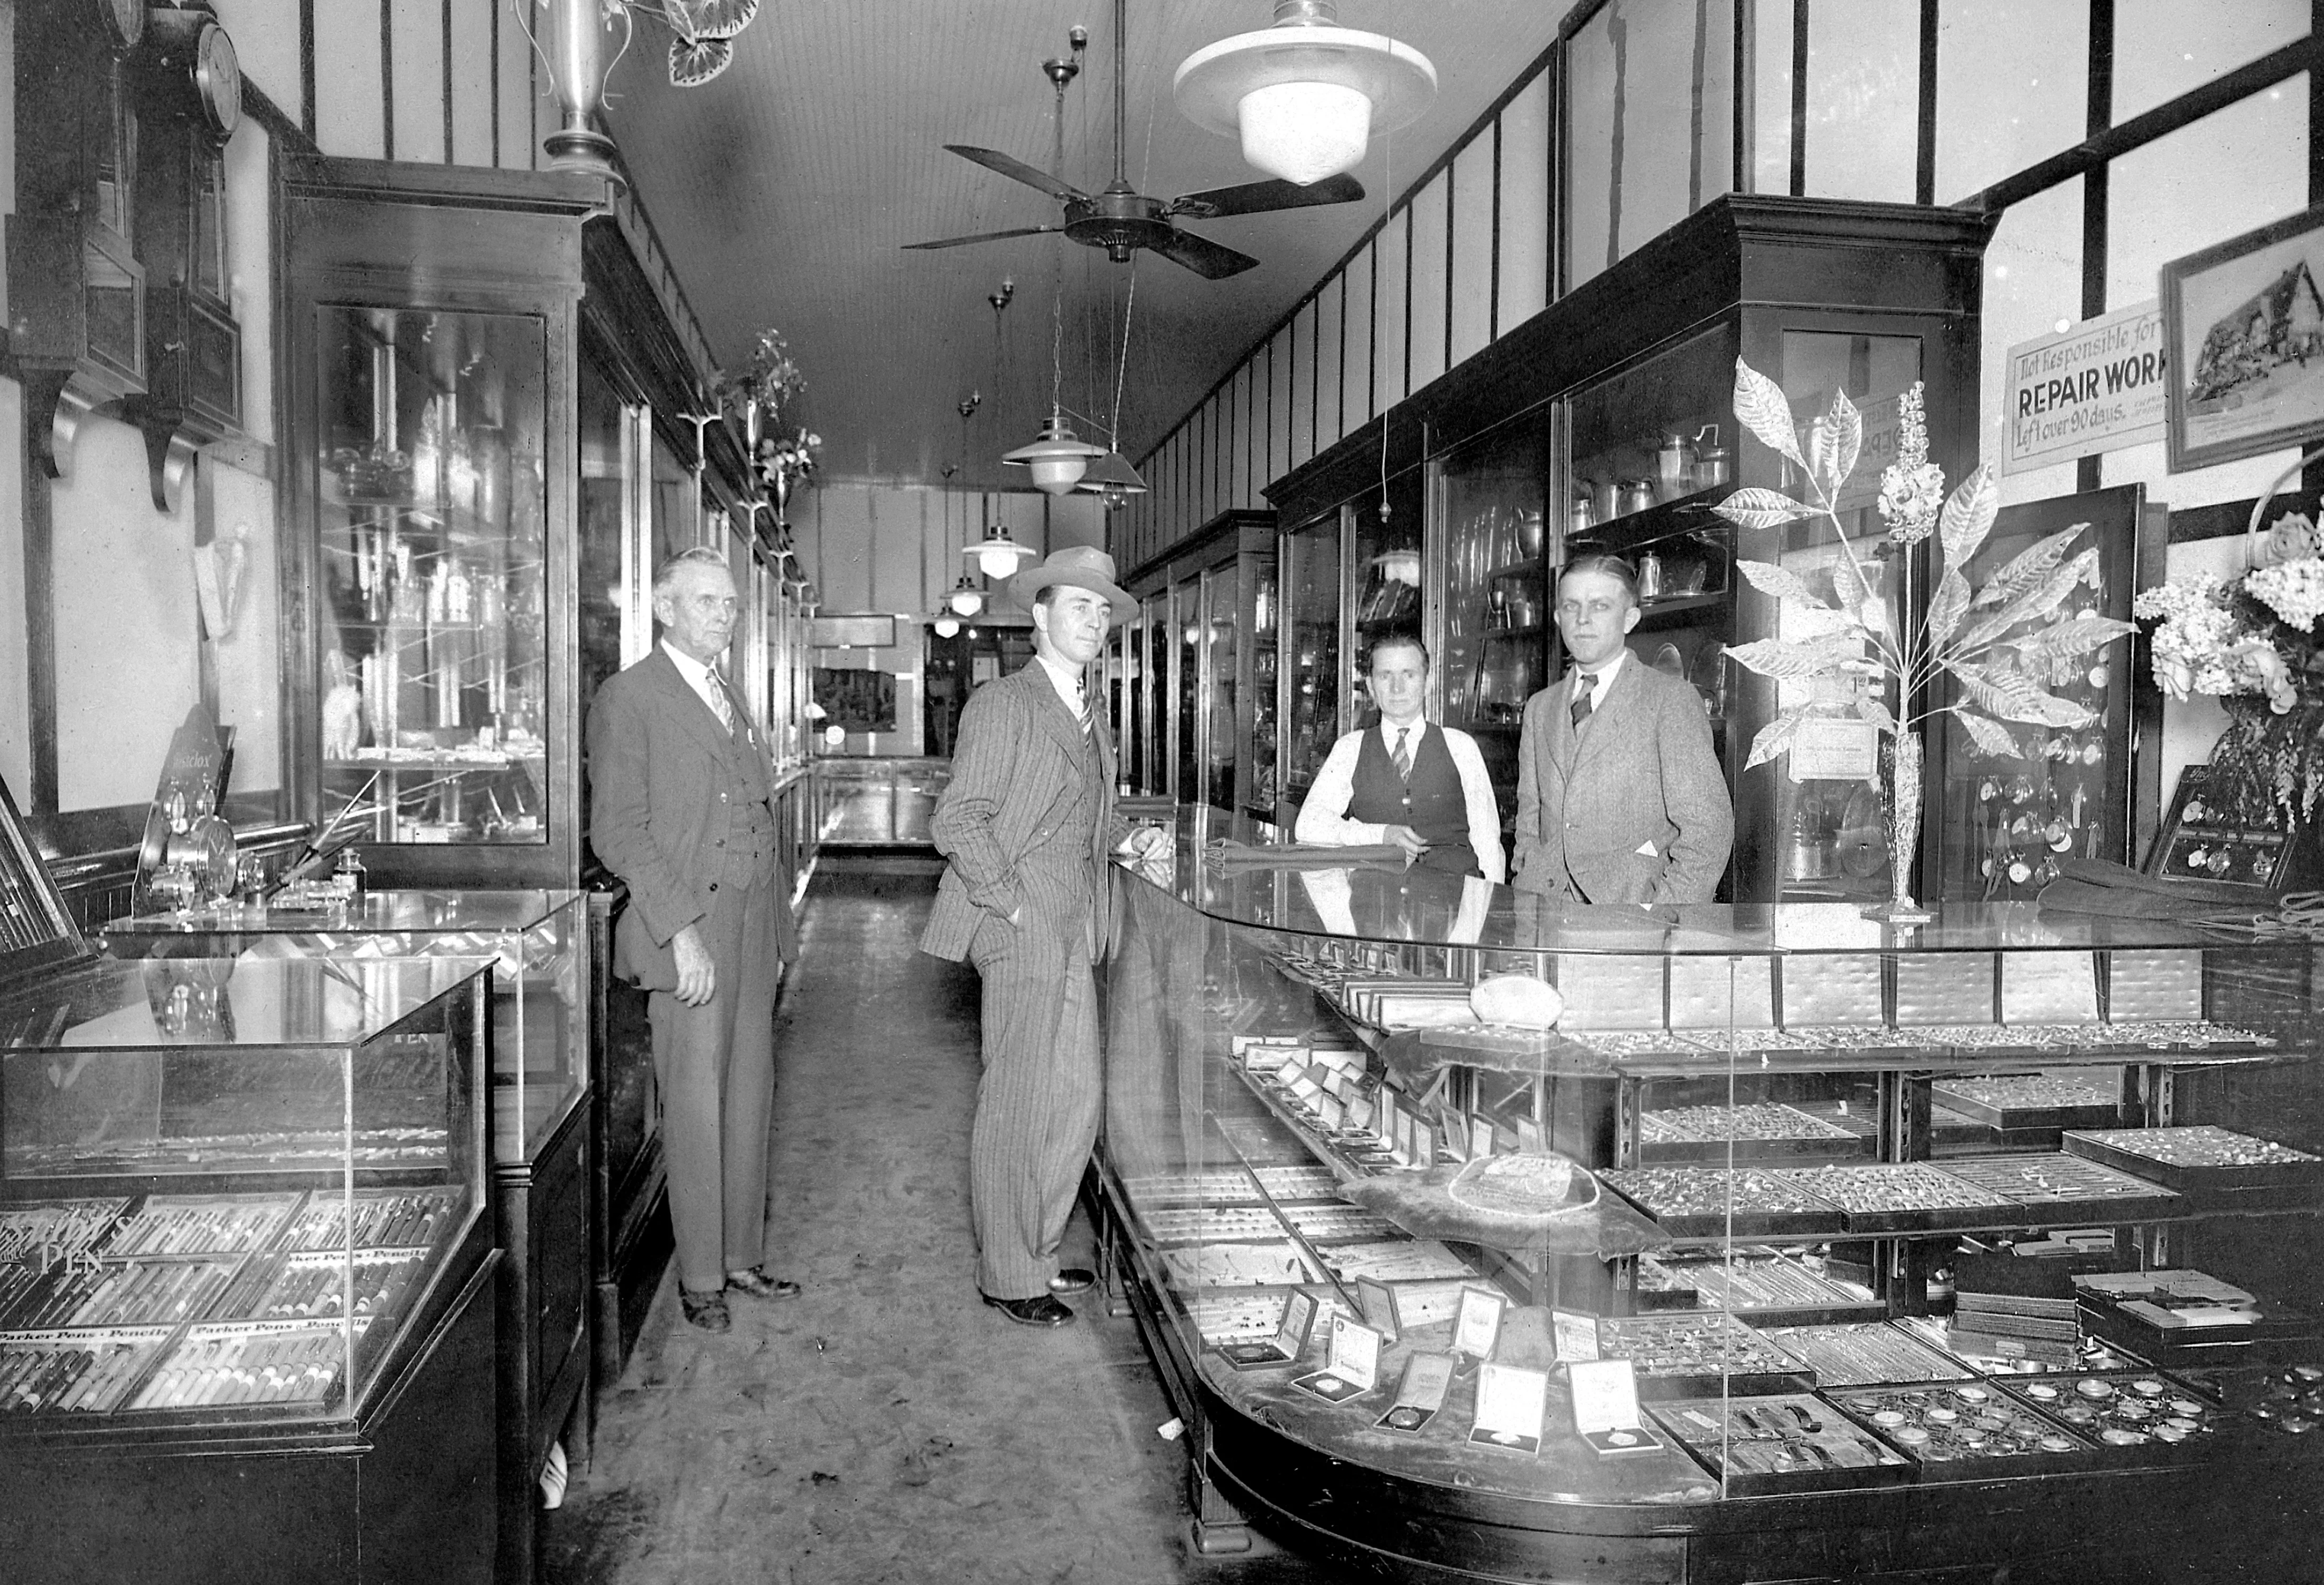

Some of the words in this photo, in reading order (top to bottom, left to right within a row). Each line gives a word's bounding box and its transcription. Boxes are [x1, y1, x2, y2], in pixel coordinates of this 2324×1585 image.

[2042, 326, 2129, 371] Responsible
[2131, 317, 2155, 352] for
[2019, 368, 2100, 419] REPAIR
[2016, 419, 2040, 453] Left
[2042, 418, 2069, 440] over
[2071, 408, 2088, 433] 90
[109, 1328, 168, 1337] Pencils
[196, 1326, 250, 1334] Parker
[307, 1319, 369, 1327] Pencls
